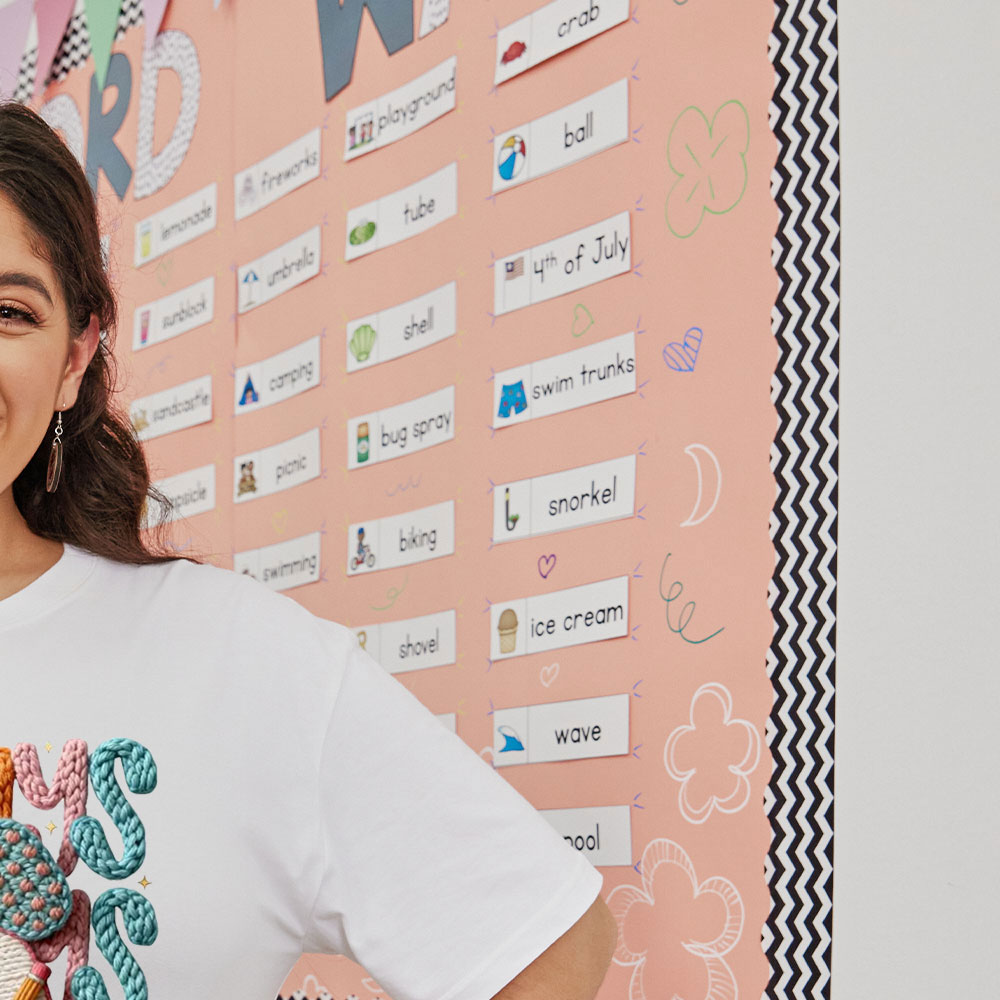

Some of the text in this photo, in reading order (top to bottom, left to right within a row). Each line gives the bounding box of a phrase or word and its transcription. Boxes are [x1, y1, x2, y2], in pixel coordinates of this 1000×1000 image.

[557, 0, 600, 38] crab
[378, 65, 456, 135] playground
[563, 110, 594, 148] ball
[262, 147, 317, 195] fireworks
[160, 199, 213, 241] lemonade
[404, 195, 436, 225] tube
[267, 245, 315, 287] umbrella
[533, 230, 629, 283] 4th of July
[162, 290, 208, 329] sunblock
[403, 306, 434, 341] shell
[269, 361, 314, 393] camping
[532, 353, 635, 399] swim trunks
[152, 387, 210, 422] sandcastle
[381, 411, 452, 449] bug spray
[276, 454, 308, 484] picnic
[548, 475, 617, 516] snorkel
[399, 526, 437, 553] biking
[263, 554, 317, 582] swimming
[531, 604, 624, 638] ice cream
[399, 627, 440, 660] shovel
[554, 724, 602, 745] wave
